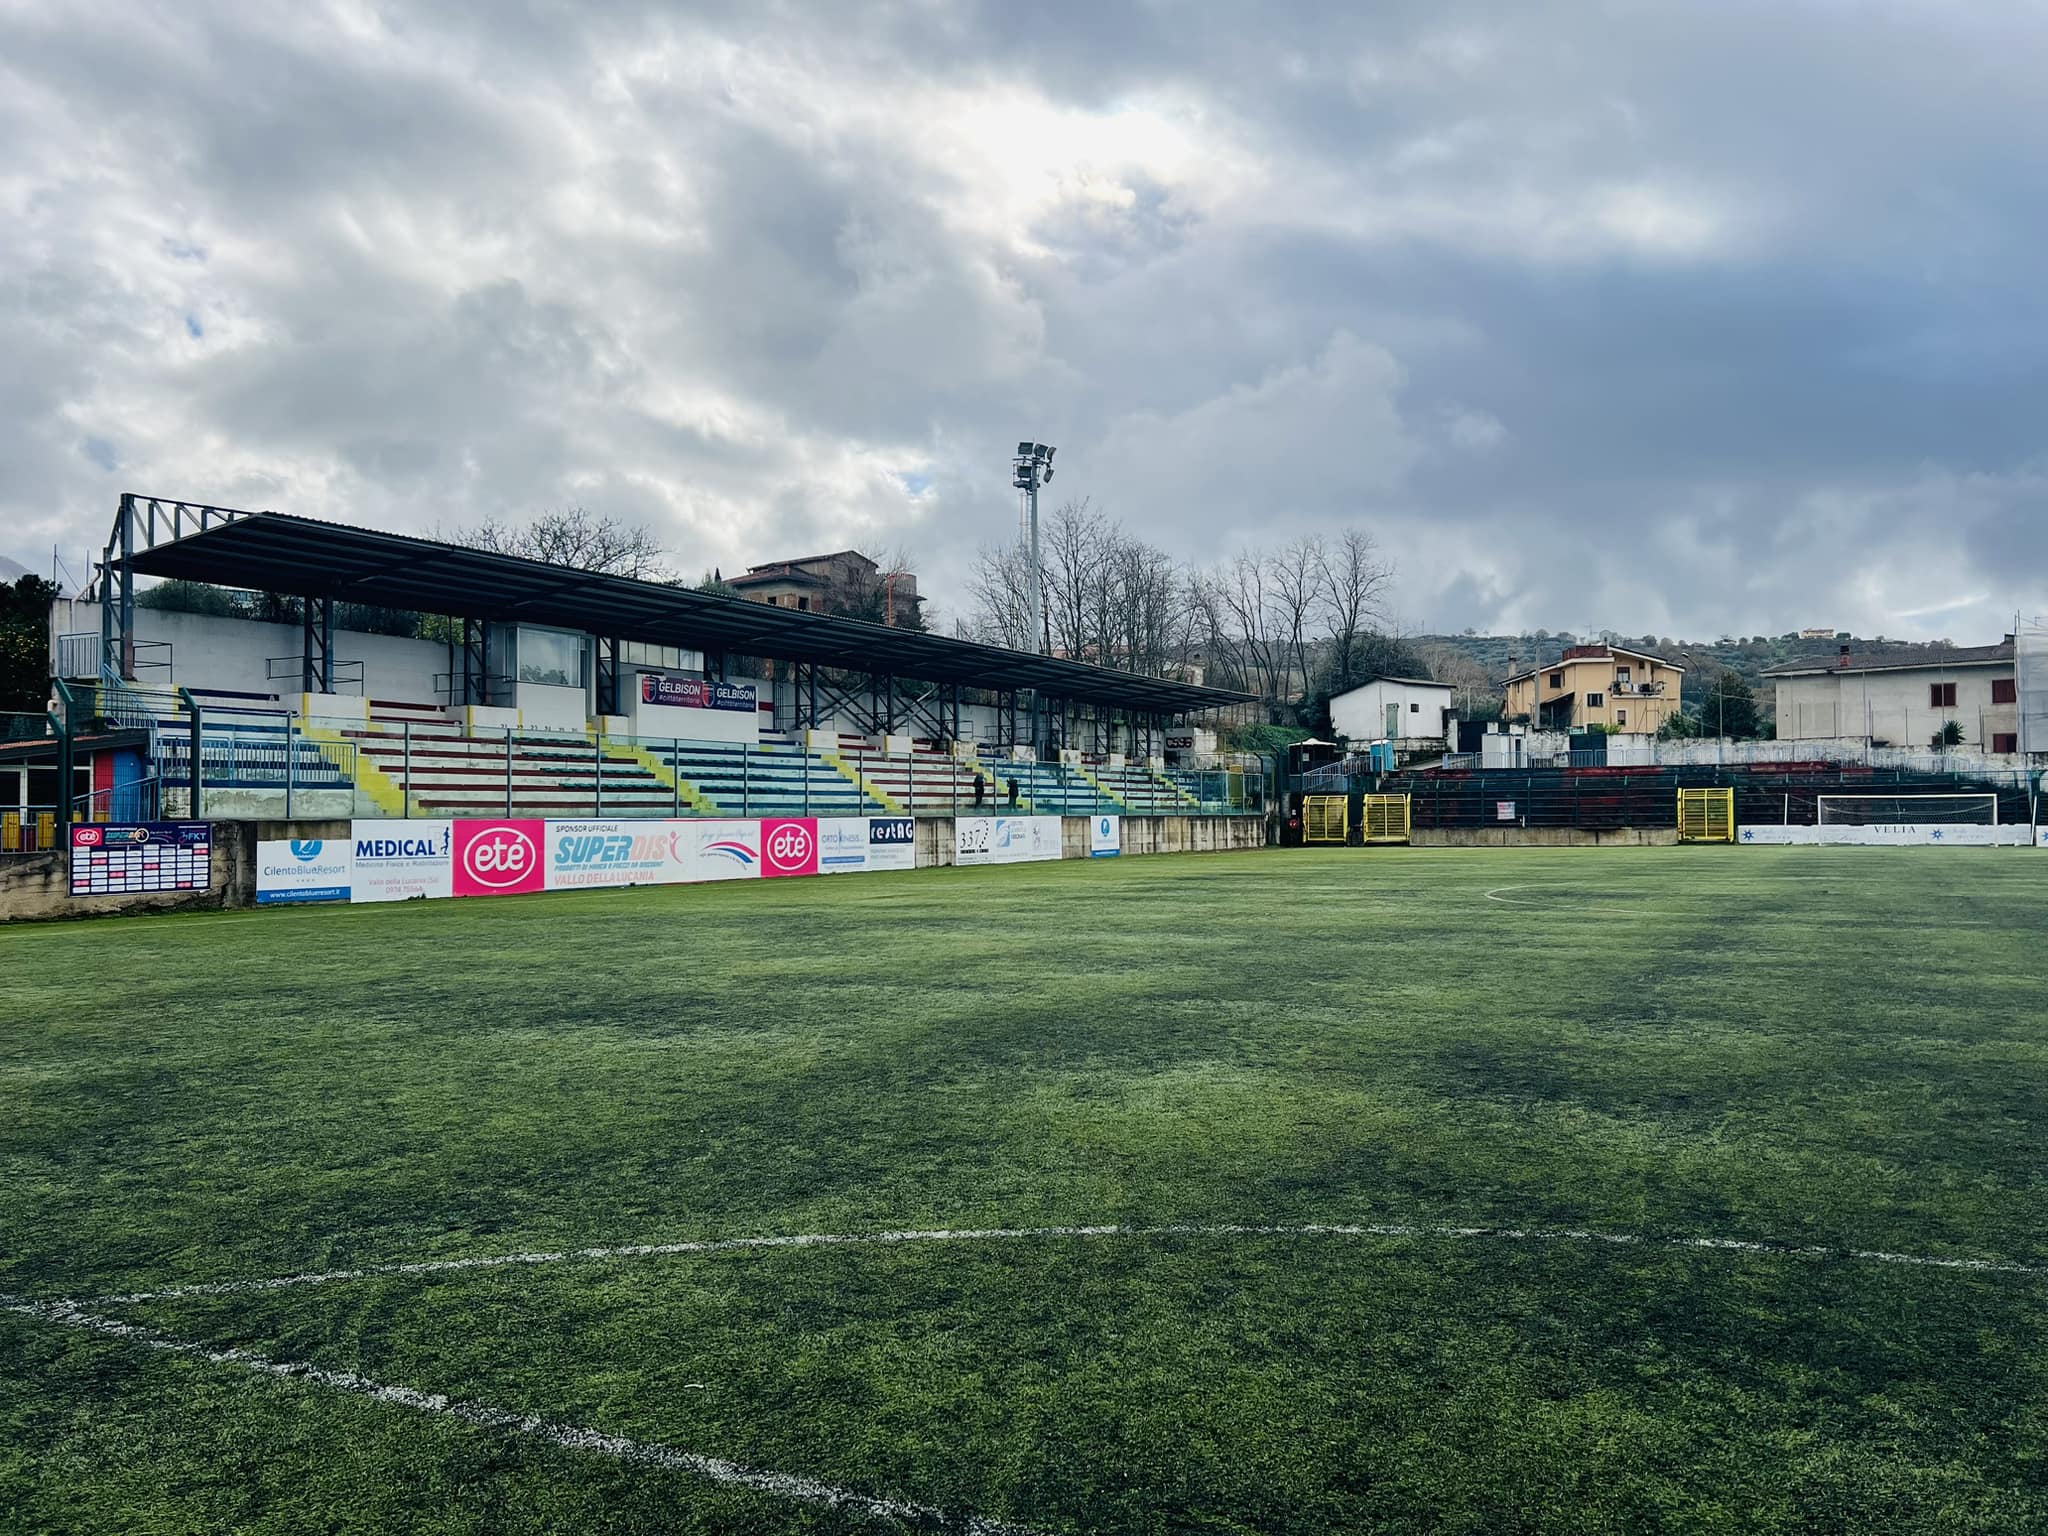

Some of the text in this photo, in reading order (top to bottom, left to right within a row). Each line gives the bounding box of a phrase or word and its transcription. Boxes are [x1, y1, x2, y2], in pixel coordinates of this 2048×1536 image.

[658, 682, 700, 695] GELBISON
[716, 687, 755, 700] GELBISON
[556, 824, 619, 833] SPONSOR UFFICIALE
[870, 822, 913, 840] restAG
[1873, 825, 1917, 834] VELIA
[774, 831, 806, 858] eté
[960, 828, 981, 849] 337
[356, 839, 436, 857] MEDICAL
[474, 834, 525, 873] eté
[555, 834, 668, 864] SUPERDIS
[264, 865, 345, 876] CilentoBlueResort
[555, 870, 654, 886] VALLO DELLA LUCANIA
